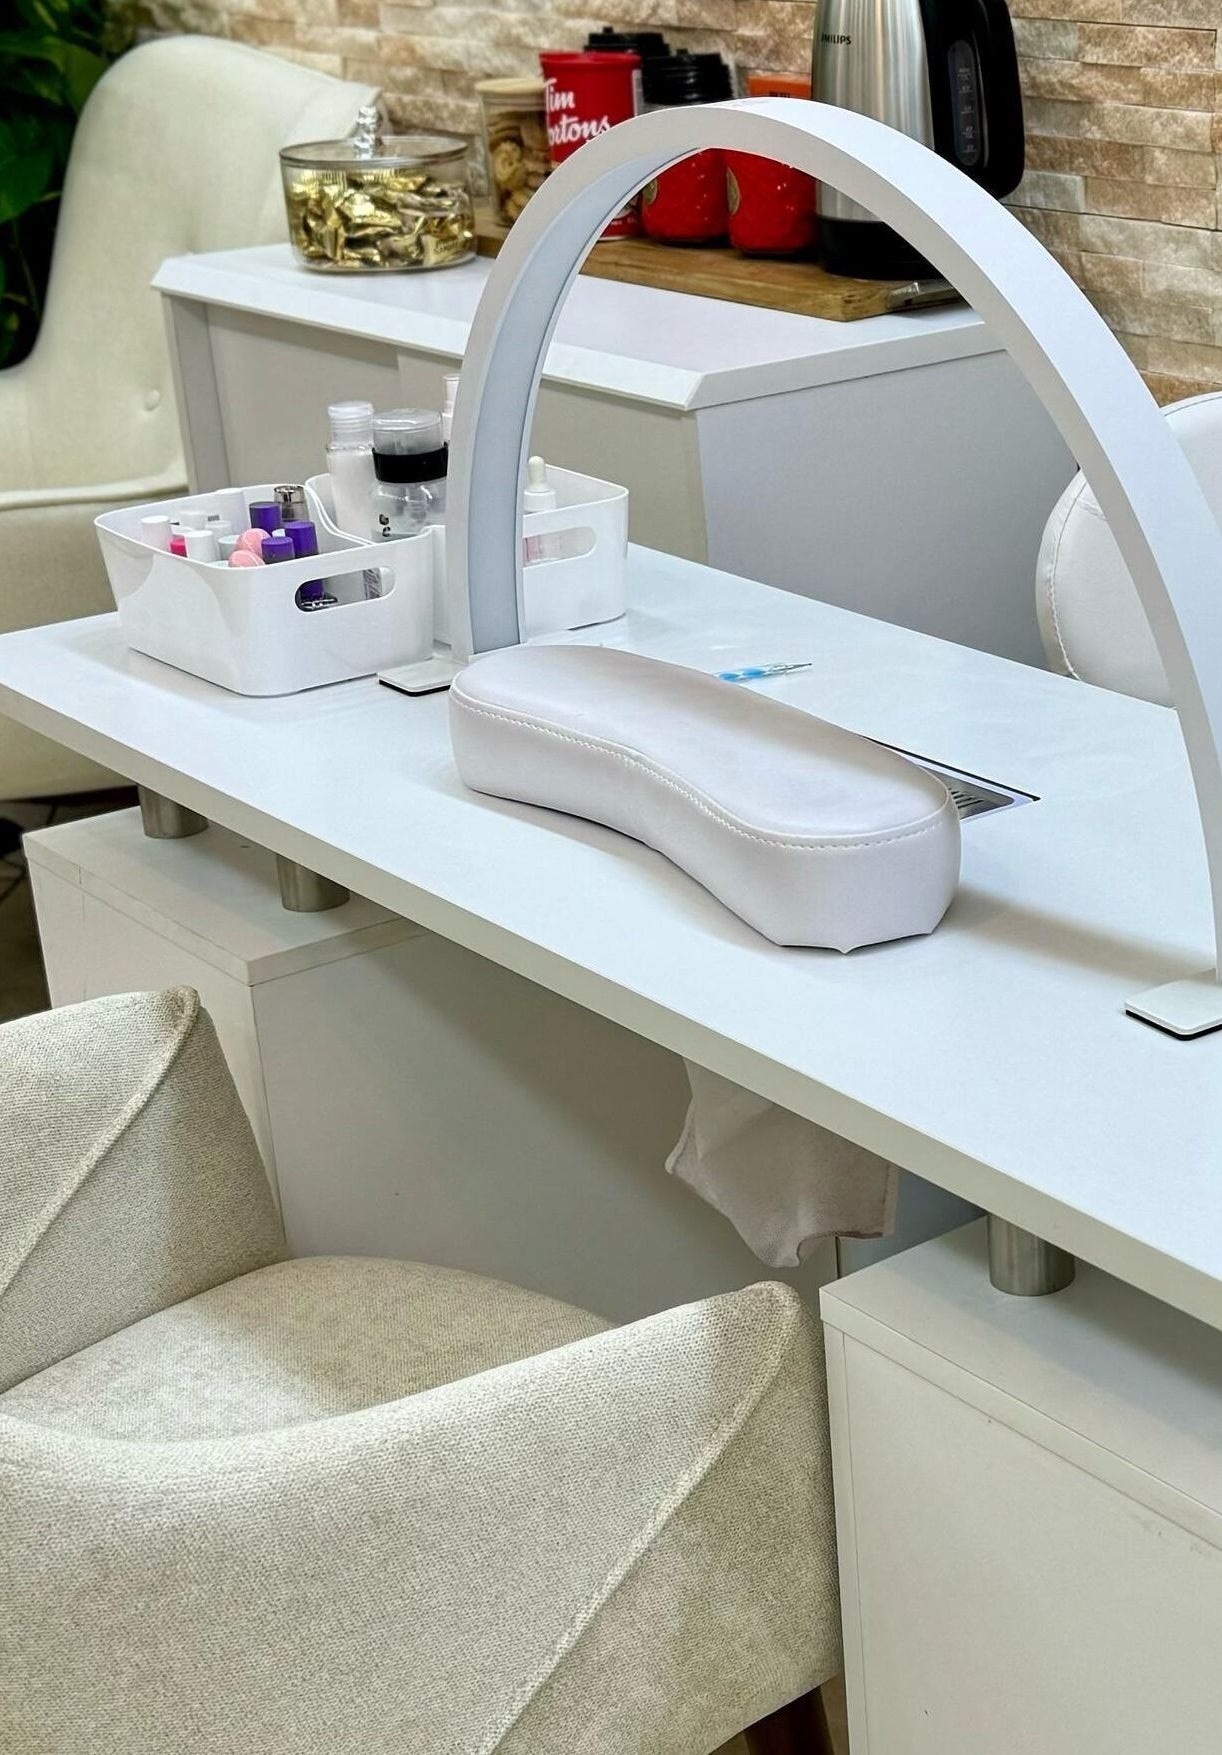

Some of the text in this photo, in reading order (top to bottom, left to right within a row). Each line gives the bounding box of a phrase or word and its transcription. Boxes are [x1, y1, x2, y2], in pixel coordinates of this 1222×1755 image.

[821, 33, 852, 45] PHILIPS
[543, 77, 576, 112] Tim
[546, 114, 611, 147] ortons
